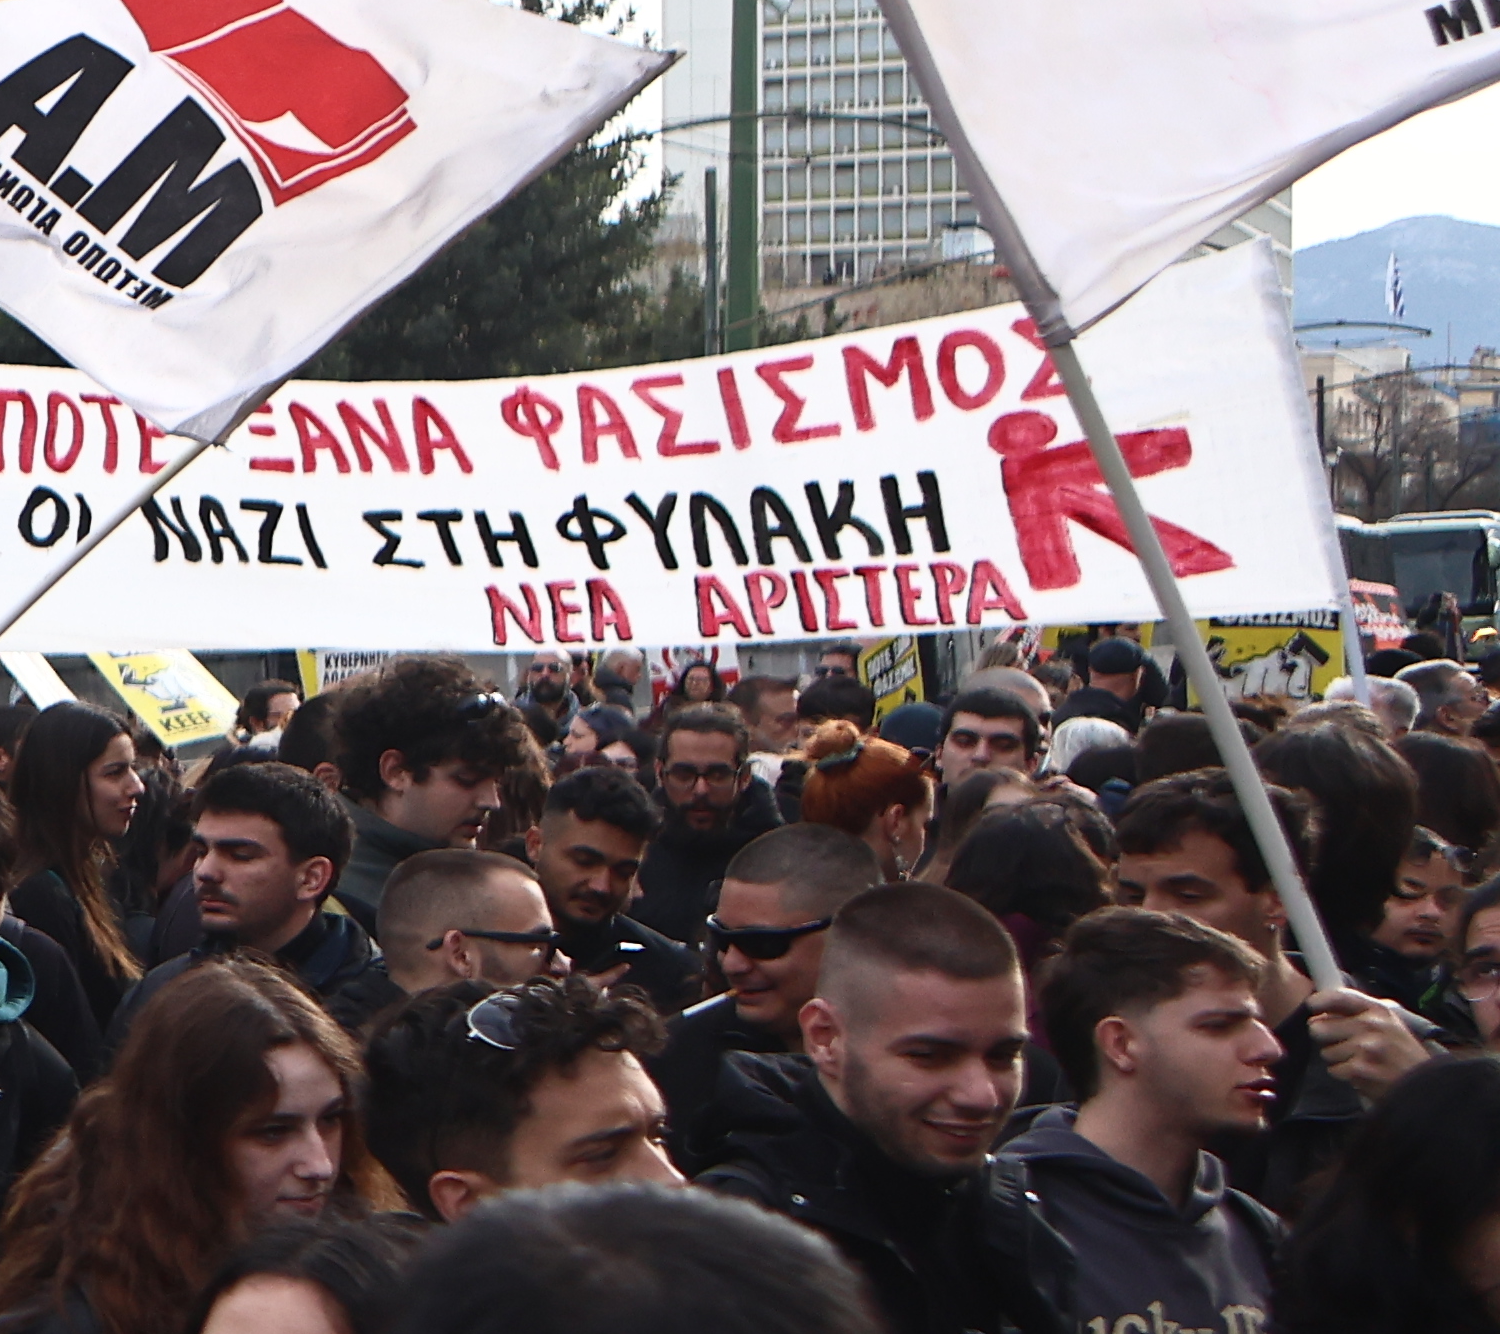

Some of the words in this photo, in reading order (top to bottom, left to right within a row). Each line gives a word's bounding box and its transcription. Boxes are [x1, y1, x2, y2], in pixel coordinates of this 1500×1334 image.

[501, 316, 1092, 471] ΦΑΣΙΣΜΟΣ
[140, 494, 329, 569] ΝΑΖΙ
[362, 509, 538, 568] ΣΤΗ
[556, 470, 952, 570] ΦΥΛΑΚΗ
[485, 577, 634, 645] ΝΕΑ
[695, 559, 1028, 638] ΑΡΙΣΤΕΡΑ
